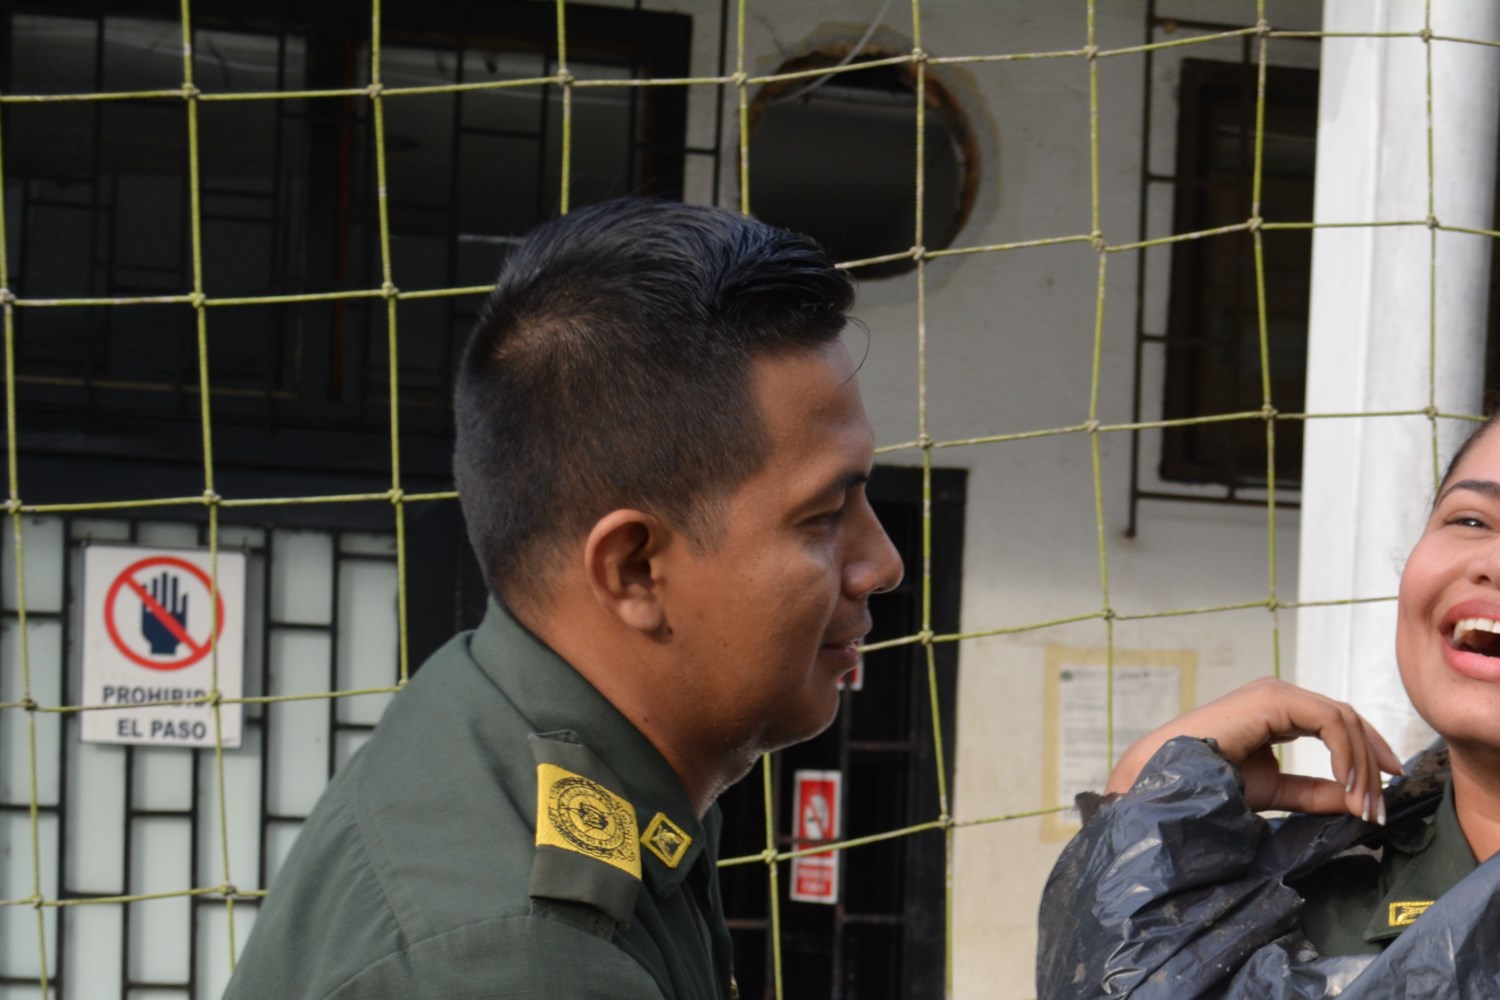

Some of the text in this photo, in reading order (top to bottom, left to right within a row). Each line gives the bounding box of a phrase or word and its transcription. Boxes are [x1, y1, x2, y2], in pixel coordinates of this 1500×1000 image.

[102, 685, 221, 708] PROHIBID
[117, 718, 206, 740] EL PASO
